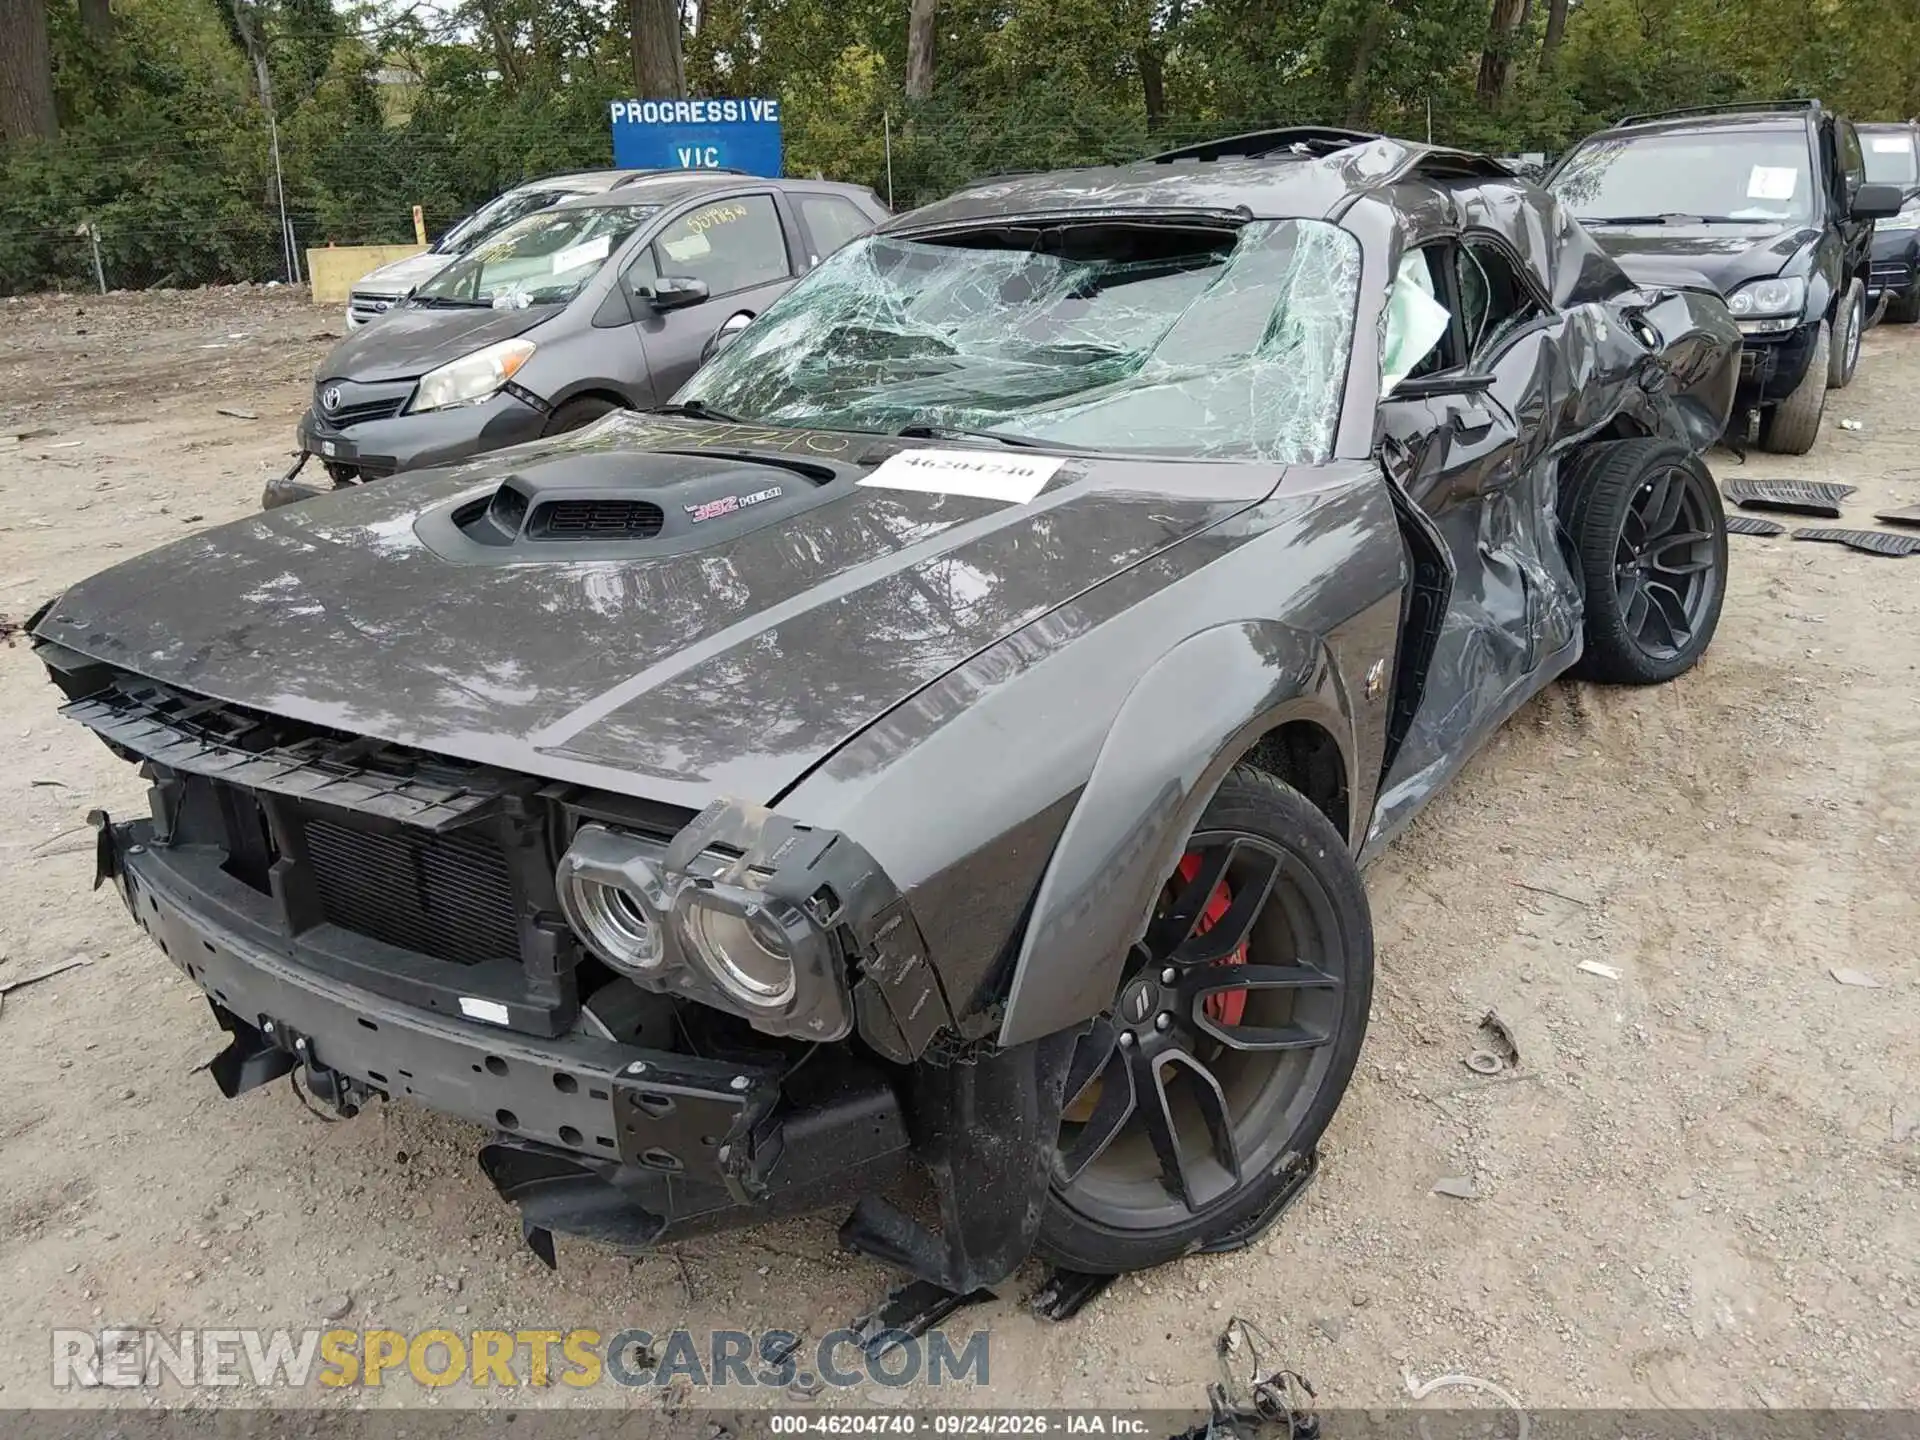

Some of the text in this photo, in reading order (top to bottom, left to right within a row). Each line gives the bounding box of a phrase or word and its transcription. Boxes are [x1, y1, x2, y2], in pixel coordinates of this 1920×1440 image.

[611, 100, 778, 123] PROGRESSIVE
[678, 147, 719, 168] VIC
[693, 496, 739, 522] 392
